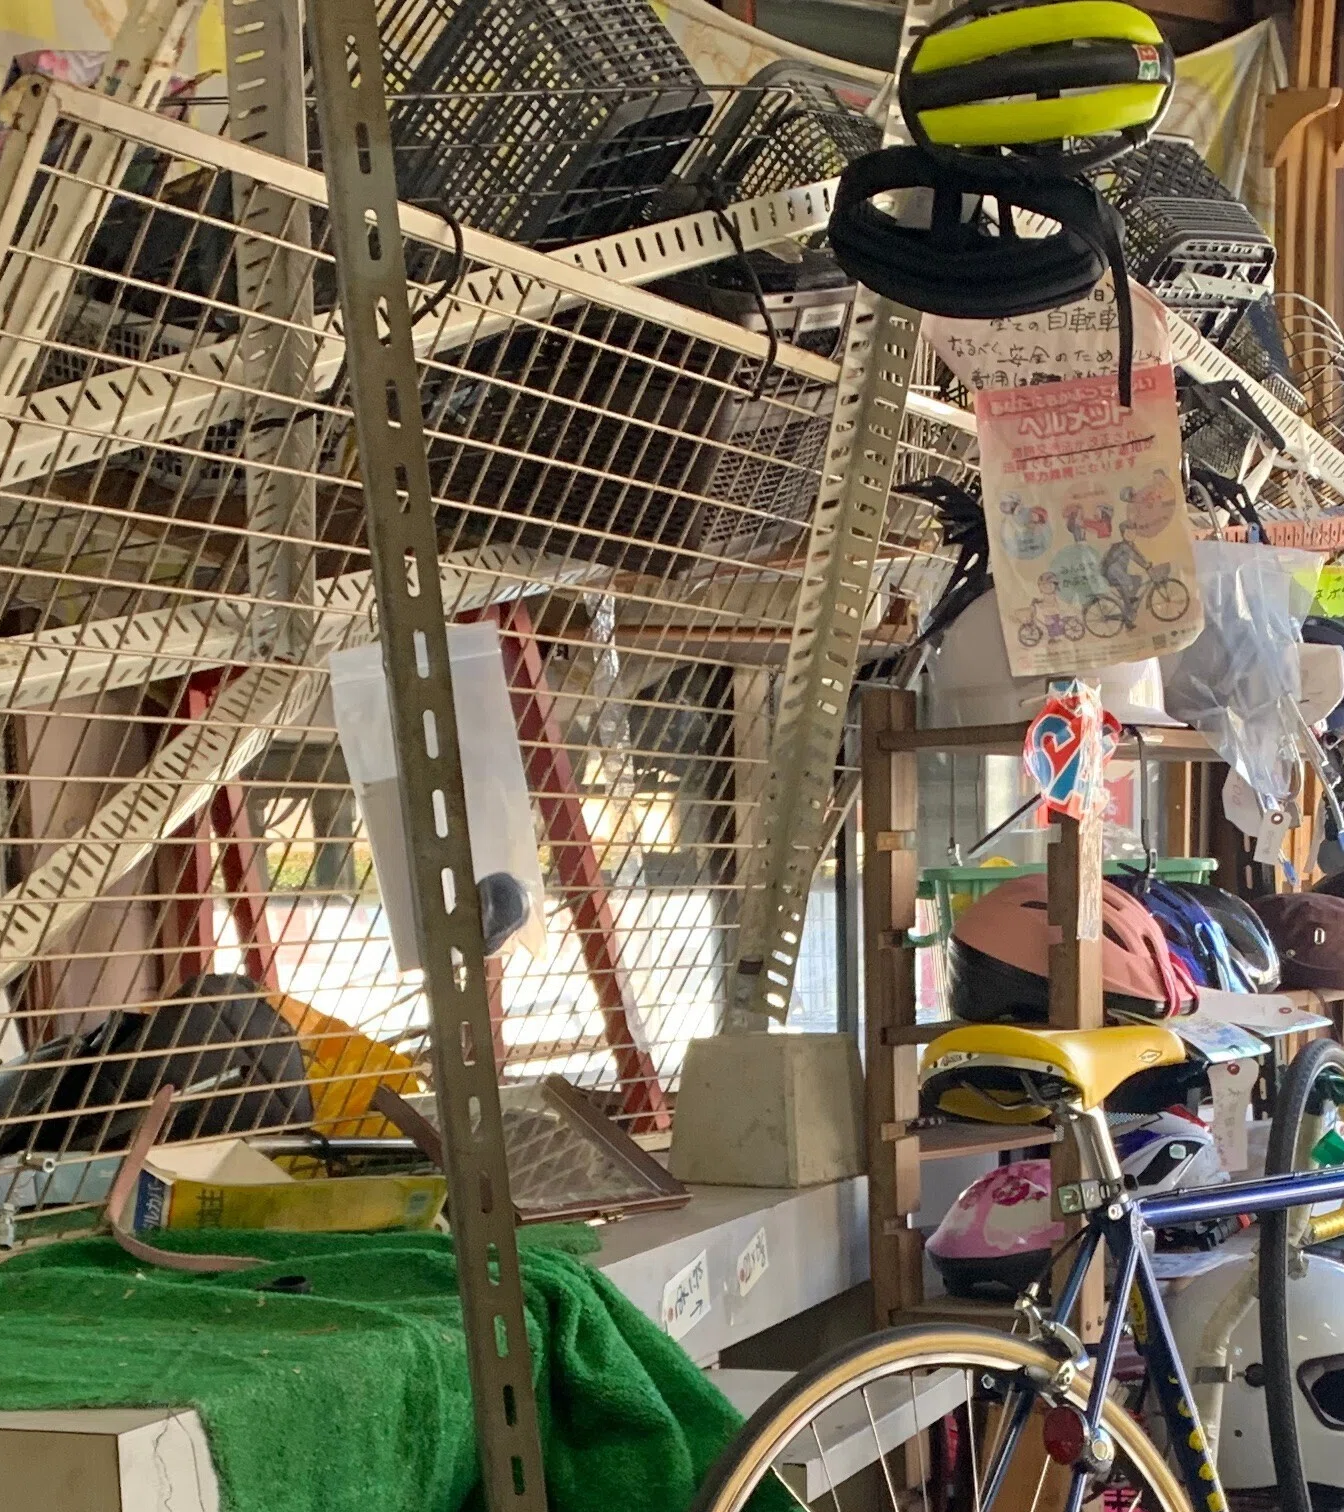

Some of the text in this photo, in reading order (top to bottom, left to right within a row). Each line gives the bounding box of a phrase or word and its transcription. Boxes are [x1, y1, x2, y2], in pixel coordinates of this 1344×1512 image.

[1018, 400, 1133, 438] ヘルメット
